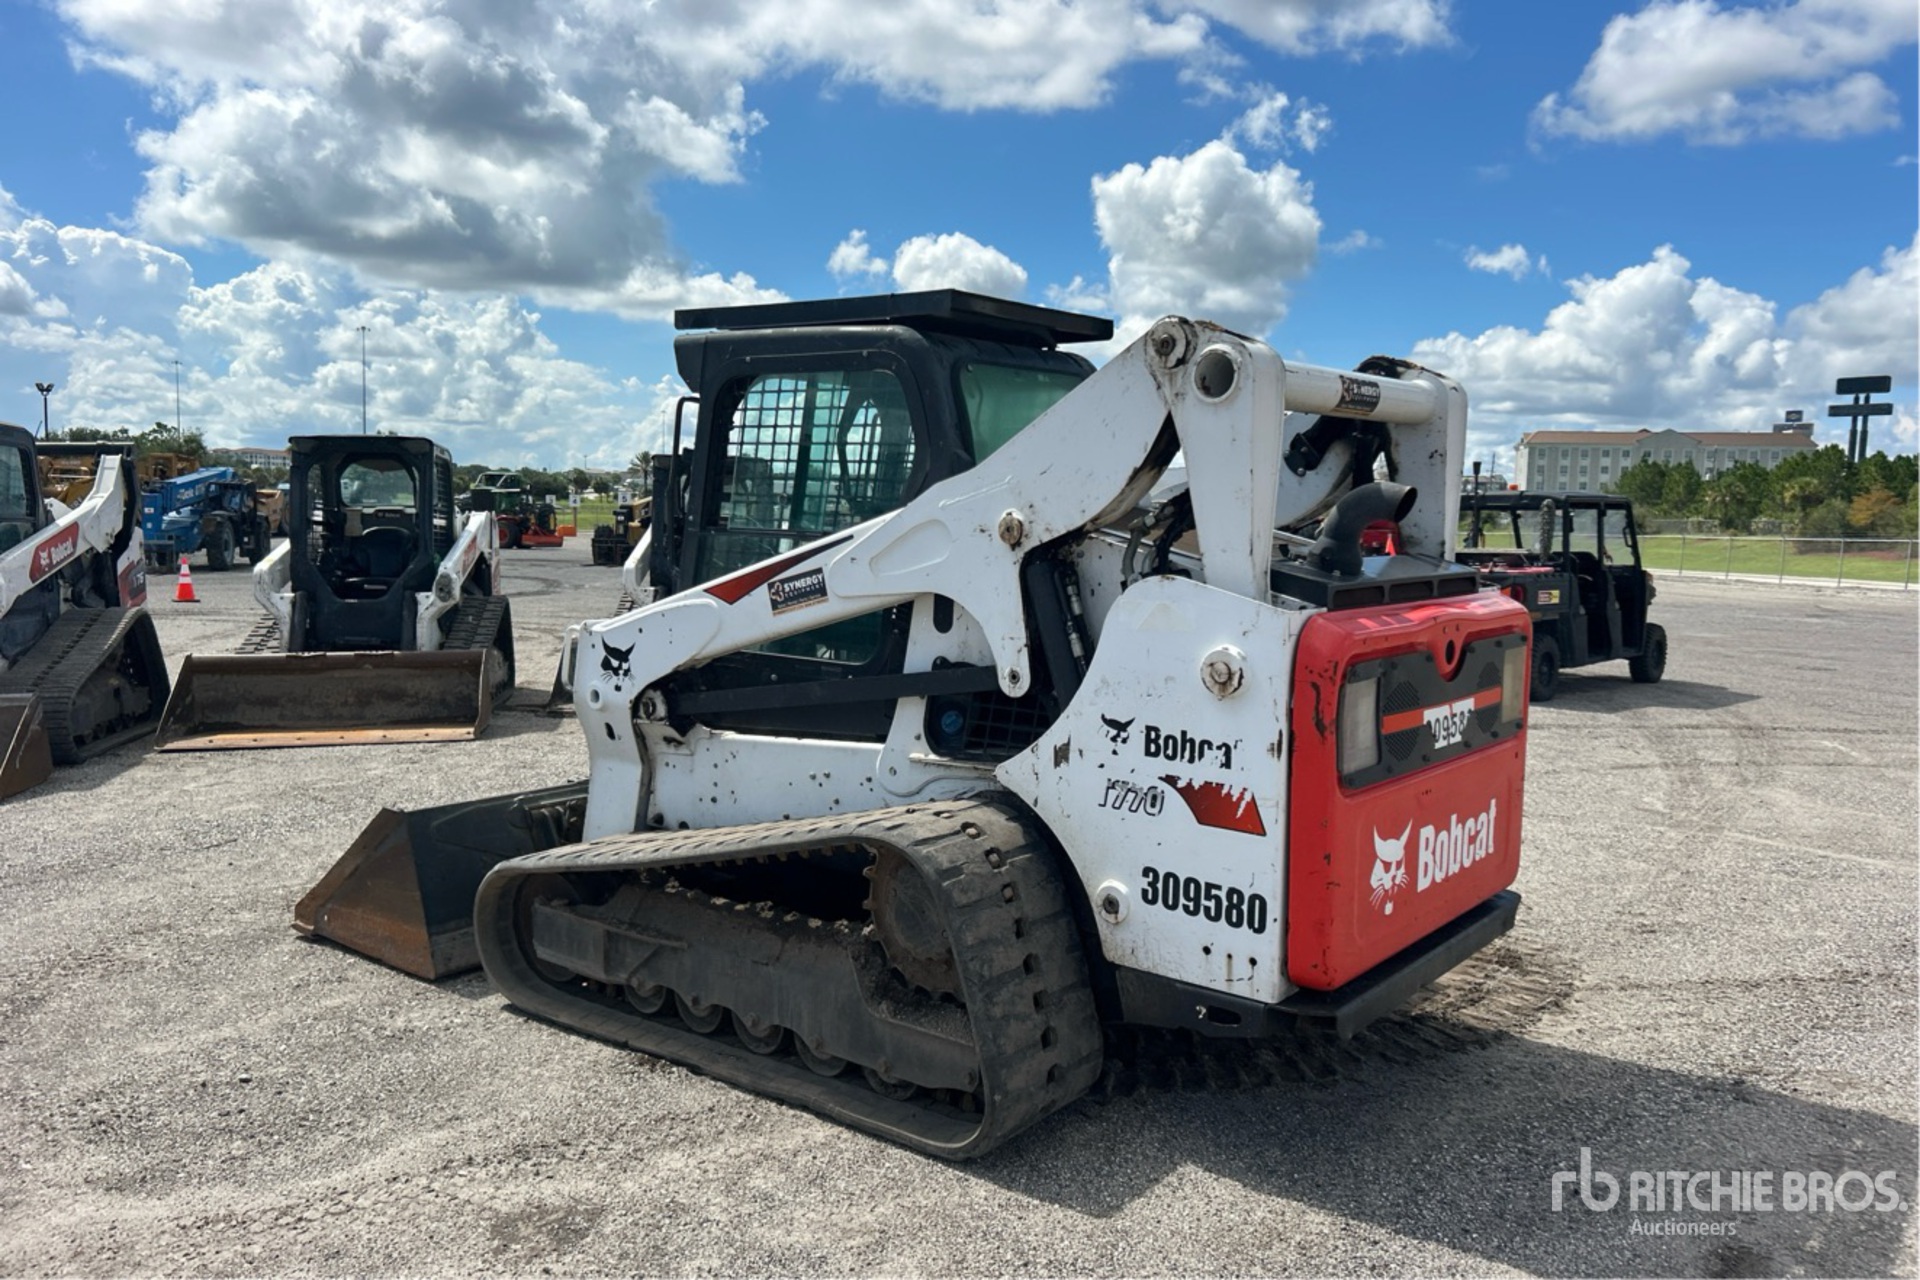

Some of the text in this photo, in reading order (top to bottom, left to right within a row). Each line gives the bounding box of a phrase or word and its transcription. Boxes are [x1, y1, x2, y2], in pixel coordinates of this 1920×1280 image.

[50, 537, 74, 565] Bobcat
[784, 573, 824, 593] SYNERGY
[1144, 725, 1243, 770] Bobca
[1417, 798, 1496, 893] Bobcat
[1141, 866, 1267, 935] 309580
